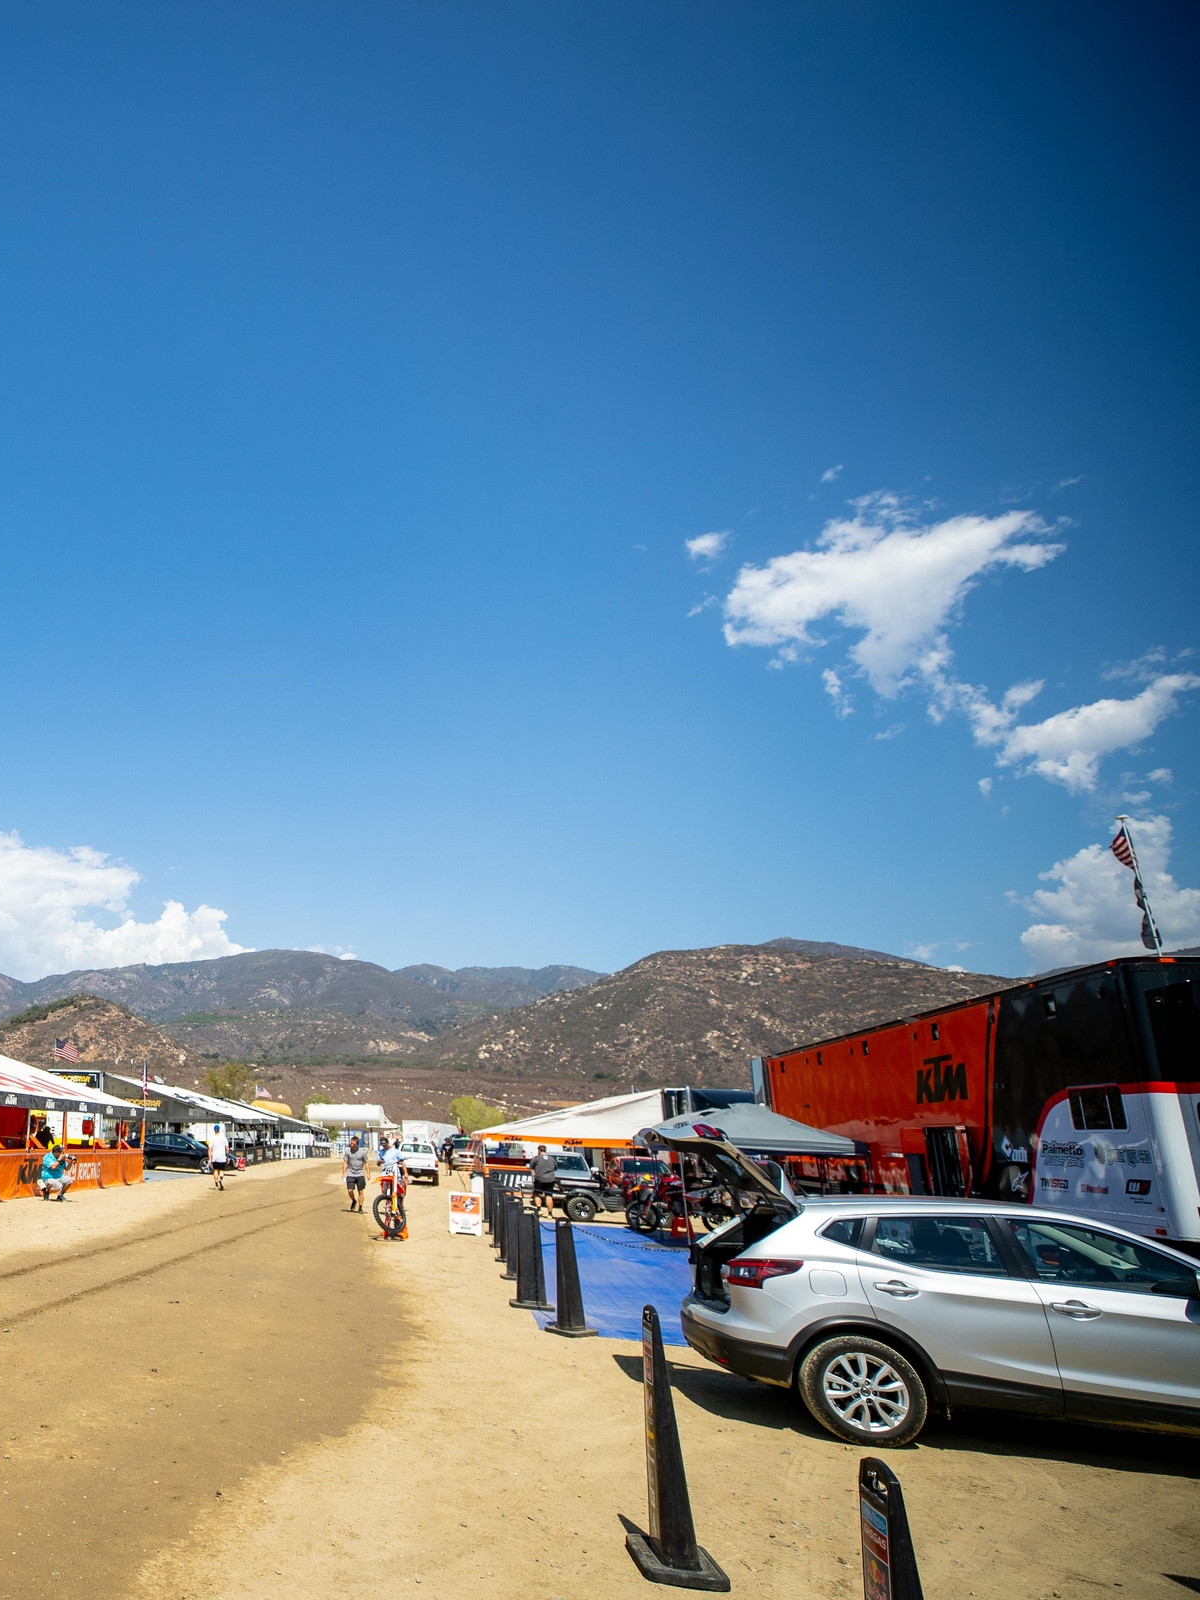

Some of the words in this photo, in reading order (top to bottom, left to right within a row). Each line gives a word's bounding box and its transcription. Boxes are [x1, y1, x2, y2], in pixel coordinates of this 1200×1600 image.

[916, 1054, 969, 1104] KTM
[5, 1094, 18, 1106] KTM
[1042, 1143, 1083, 1156] Palmetto
[77, 1162, 101, 1181] RACING
[1040, 1177, 1069, 1189] TWISTED
